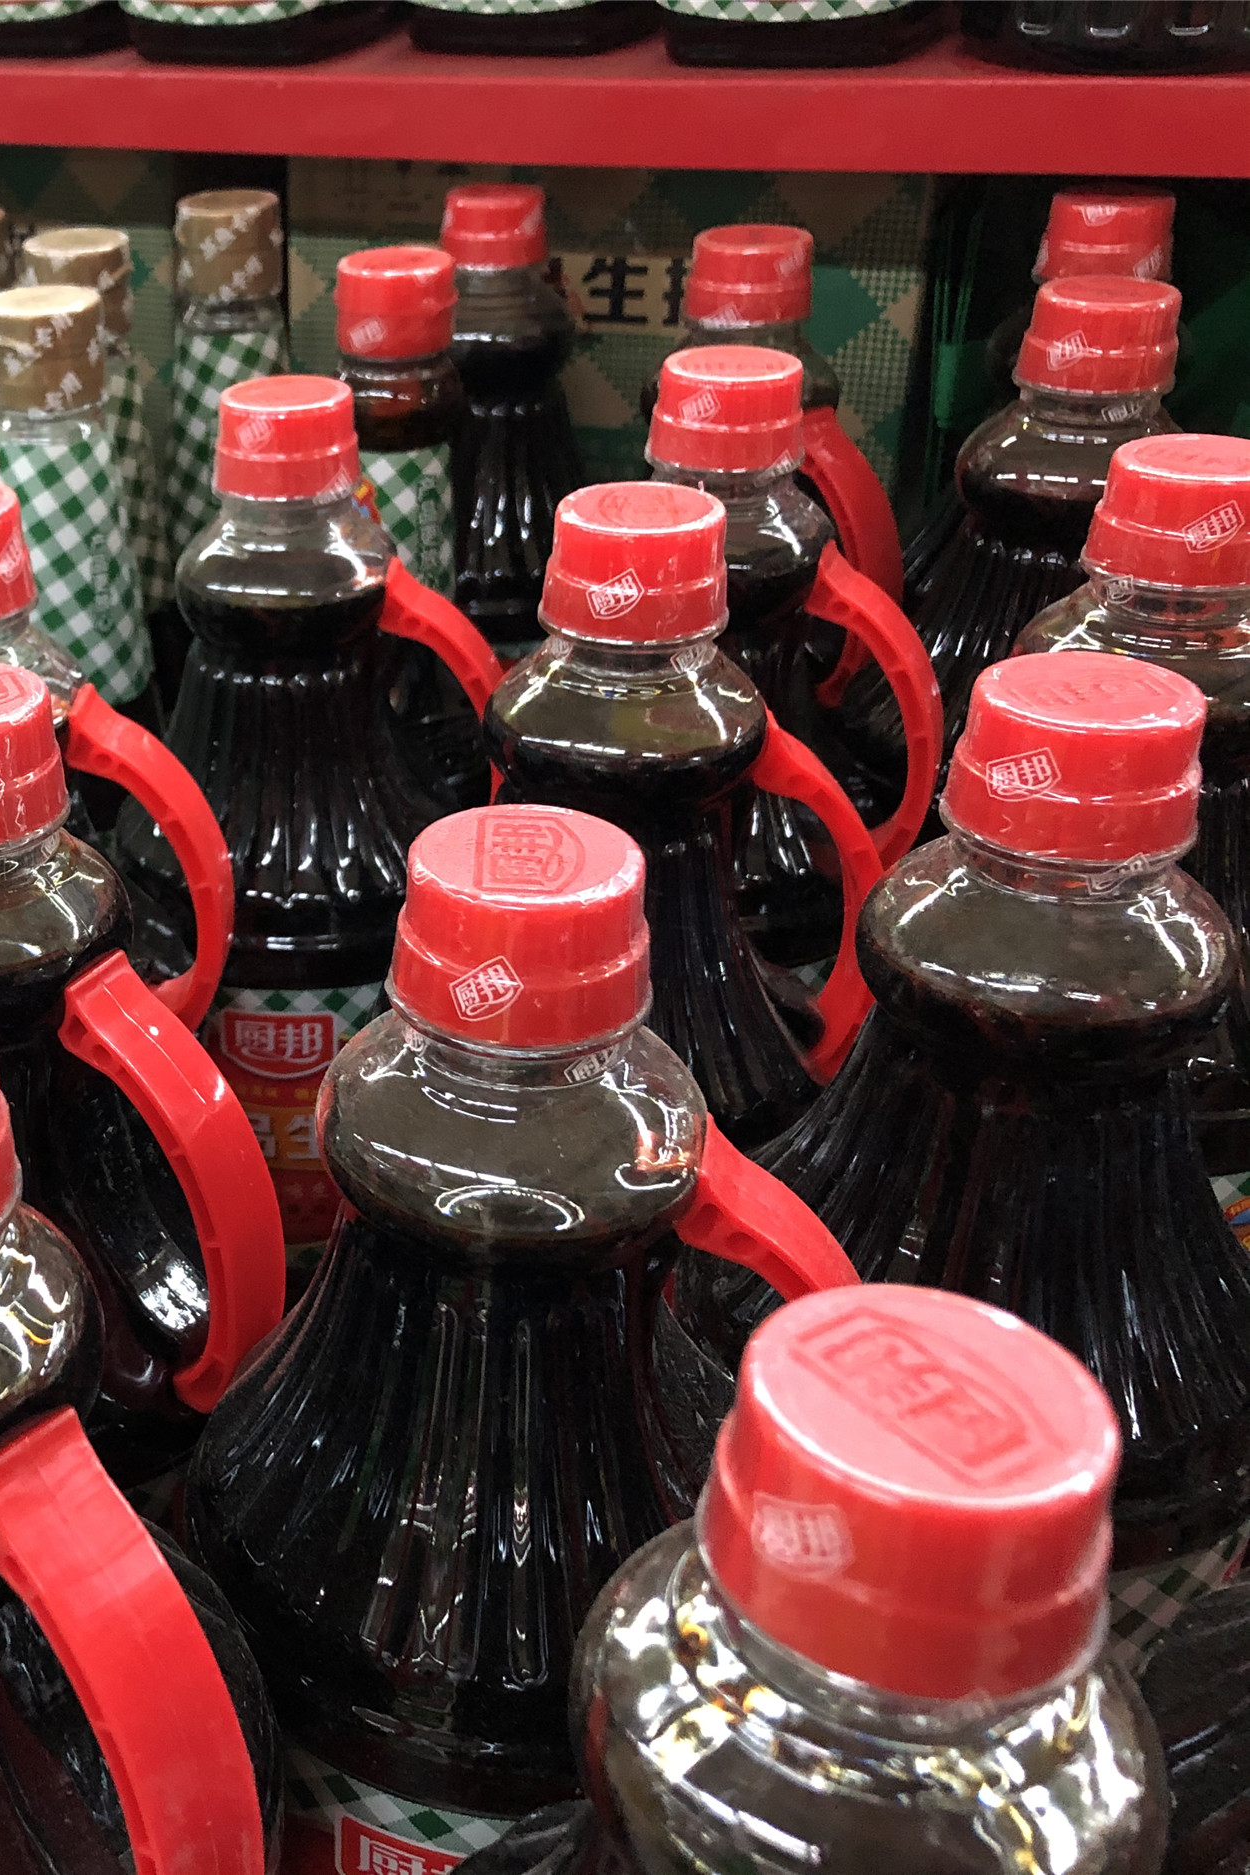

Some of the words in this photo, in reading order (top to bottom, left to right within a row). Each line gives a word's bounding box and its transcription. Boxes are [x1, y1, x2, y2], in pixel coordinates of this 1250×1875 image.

[991, 754, 1053, 794] 厨邦
[455, 964, 514, 1014] 厨邦
[235, 1019, 325, 1063] 厨邦
